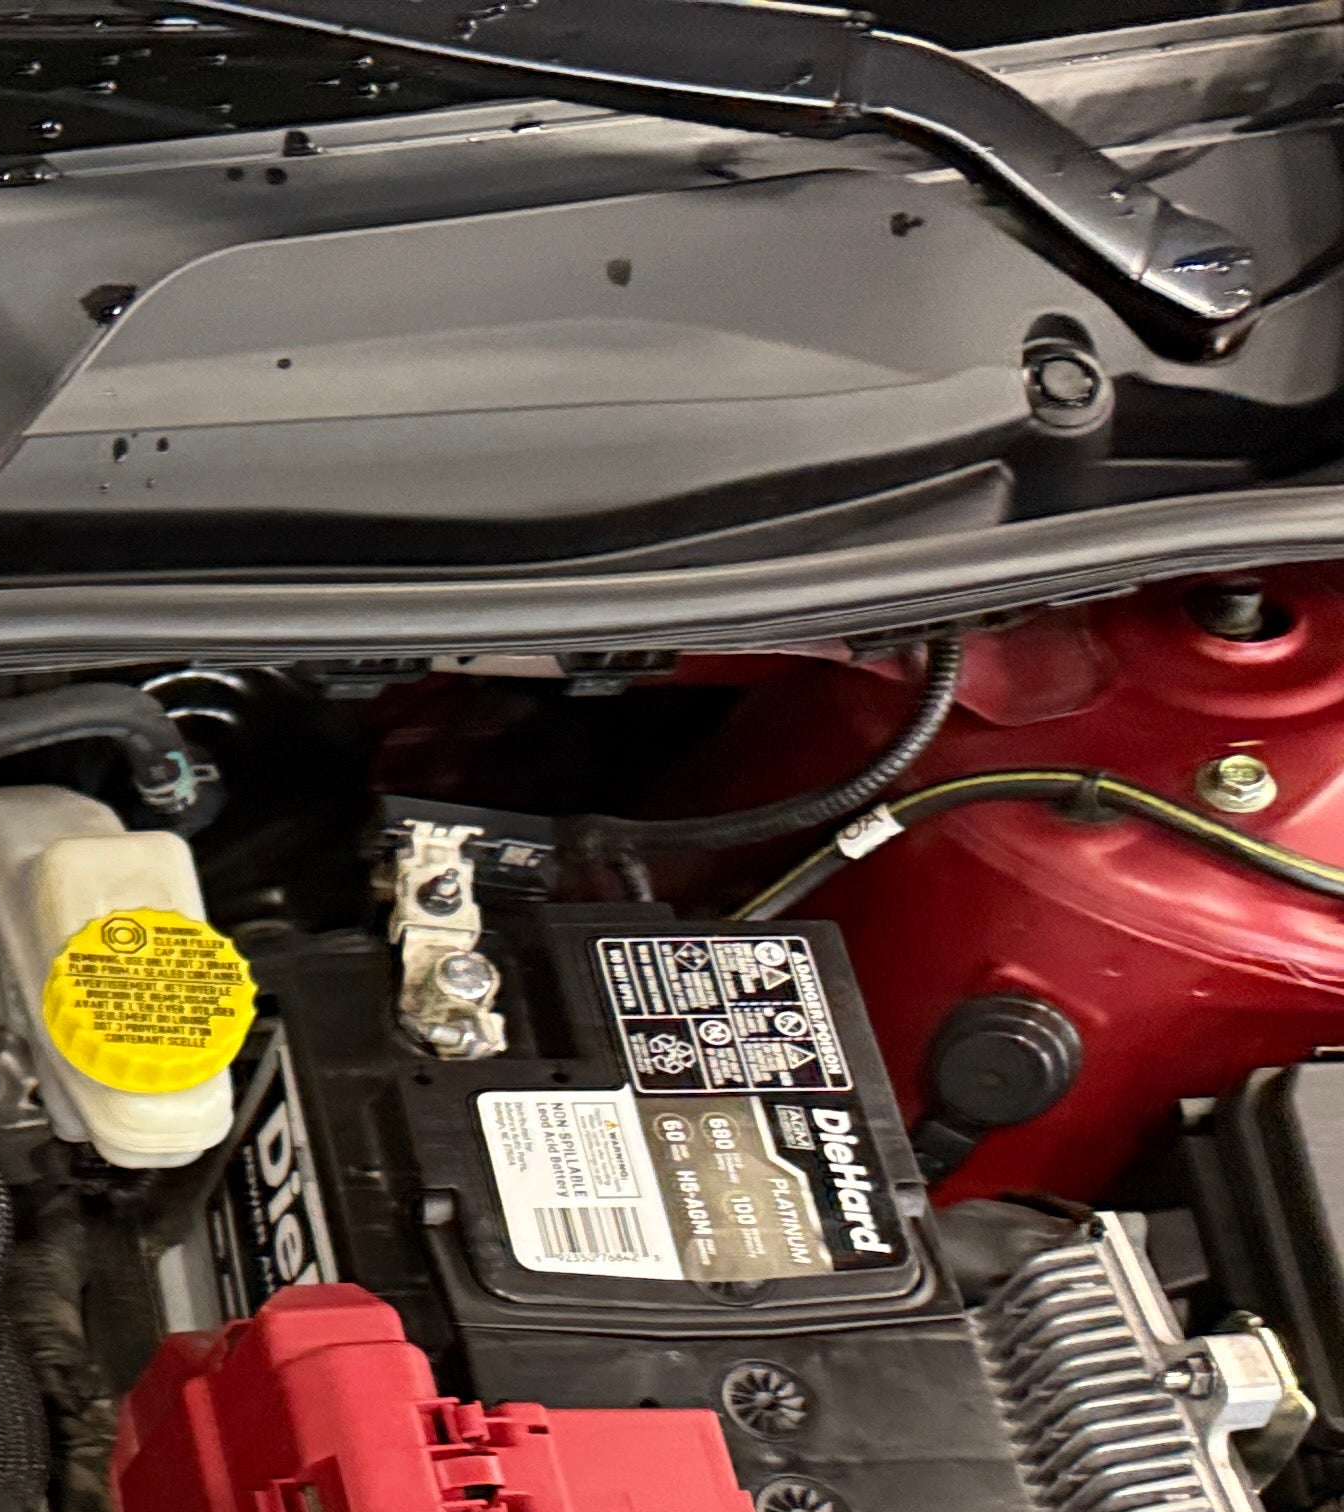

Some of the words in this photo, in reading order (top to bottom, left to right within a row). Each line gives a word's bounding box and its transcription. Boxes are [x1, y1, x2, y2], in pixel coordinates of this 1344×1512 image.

[154, 948, 176, 956] CAP
[536, 1102, 552, 1128] Lead
[660, 1119, 686, 1141] 60
[788, 1110, 809, 1146] AGM
[543, 1131, 560, 1152] Acid
[707, 1117, 736, 1149] 680
[257, 1101, 320, 1285] Die
[812, 1108, 892, 1255] DieHard
[729, 1196, 758, 1225] 100
[767, 1178, 813, 1263] PLATINUM
